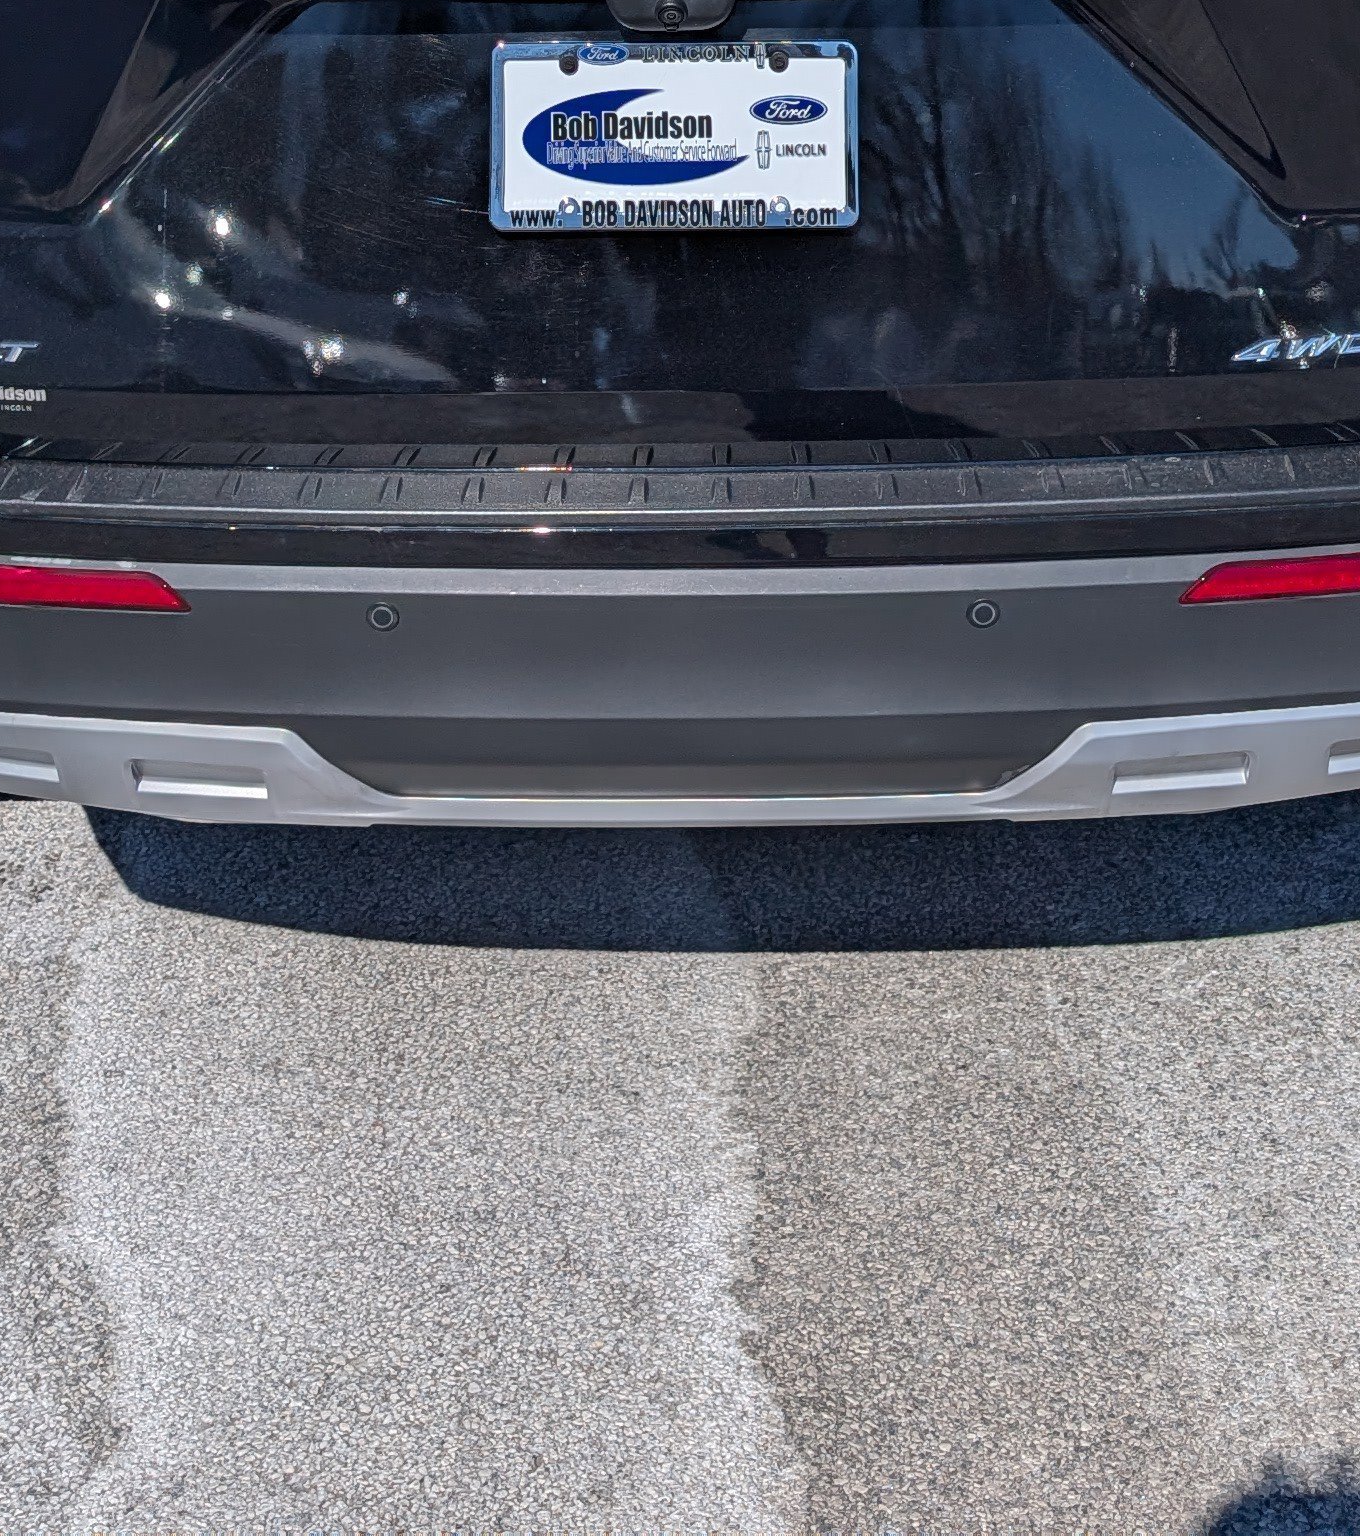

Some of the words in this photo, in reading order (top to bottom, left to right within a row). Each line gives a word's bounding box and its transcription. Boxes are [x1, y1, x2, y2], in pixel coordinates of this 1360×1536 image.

[640, 44, 751, 64] LINCOLN
[765, 99, 812, 119] Ford
[551, 112, 598, 141] Bob
[603, 111, 713, 140] Davidson
[775, 143, 828, 157] LINCOLN
[510, 209, 564, 227] www.
[581, 200, 618, 227] BOB
[624, 200, 714, 227] DAVIDSON
[720, 199, 767, 227] AUTO
